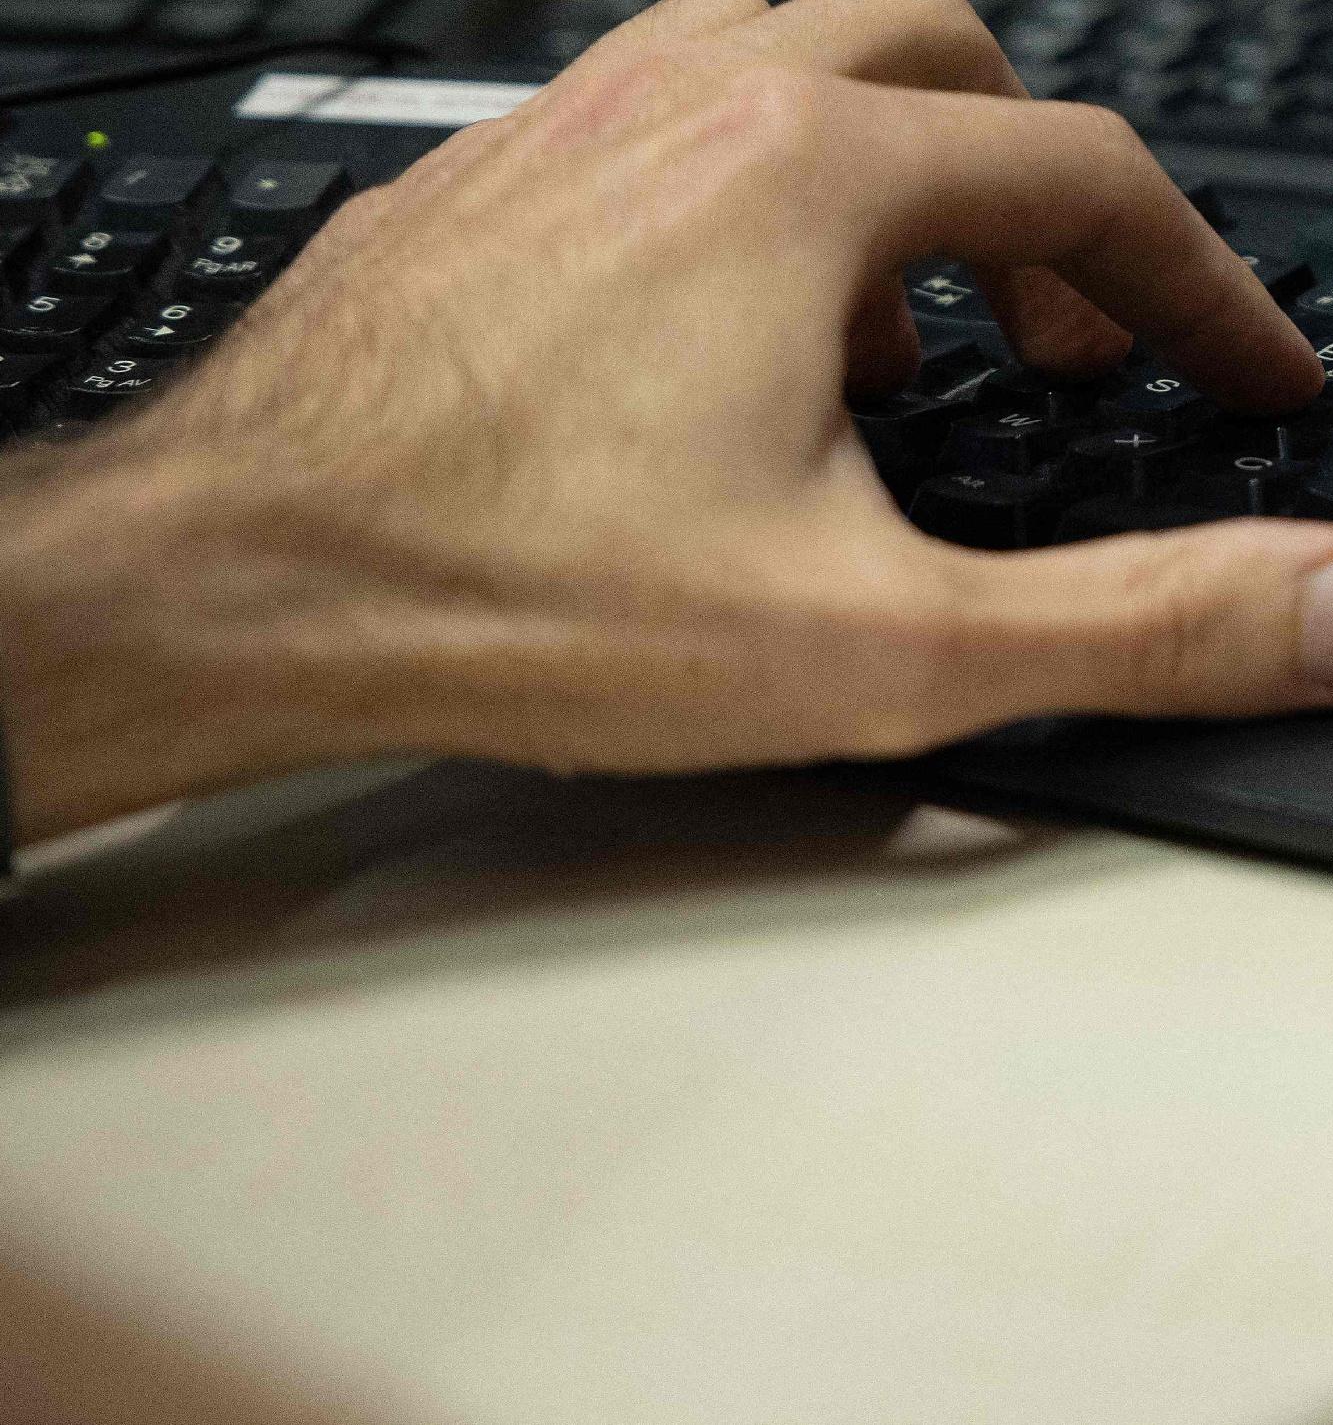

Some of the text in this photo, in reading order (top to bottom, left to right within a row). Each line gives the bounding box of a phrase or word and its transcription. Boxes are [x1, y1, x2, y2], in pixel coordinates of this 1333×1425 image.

[80, 231, 113, 251] 8
[210, 235, 244, 255] 9
[26, 295, 62, 313] 5
[160, 304, 193, 321] 6
[106, 359, 138, 374] 3
[84, 374, 153, 389] Pg AV
[1144, 377, 1181, 393] S
[997, 412, 1043, 427] W
[1233, 456, 1274, 472] C
